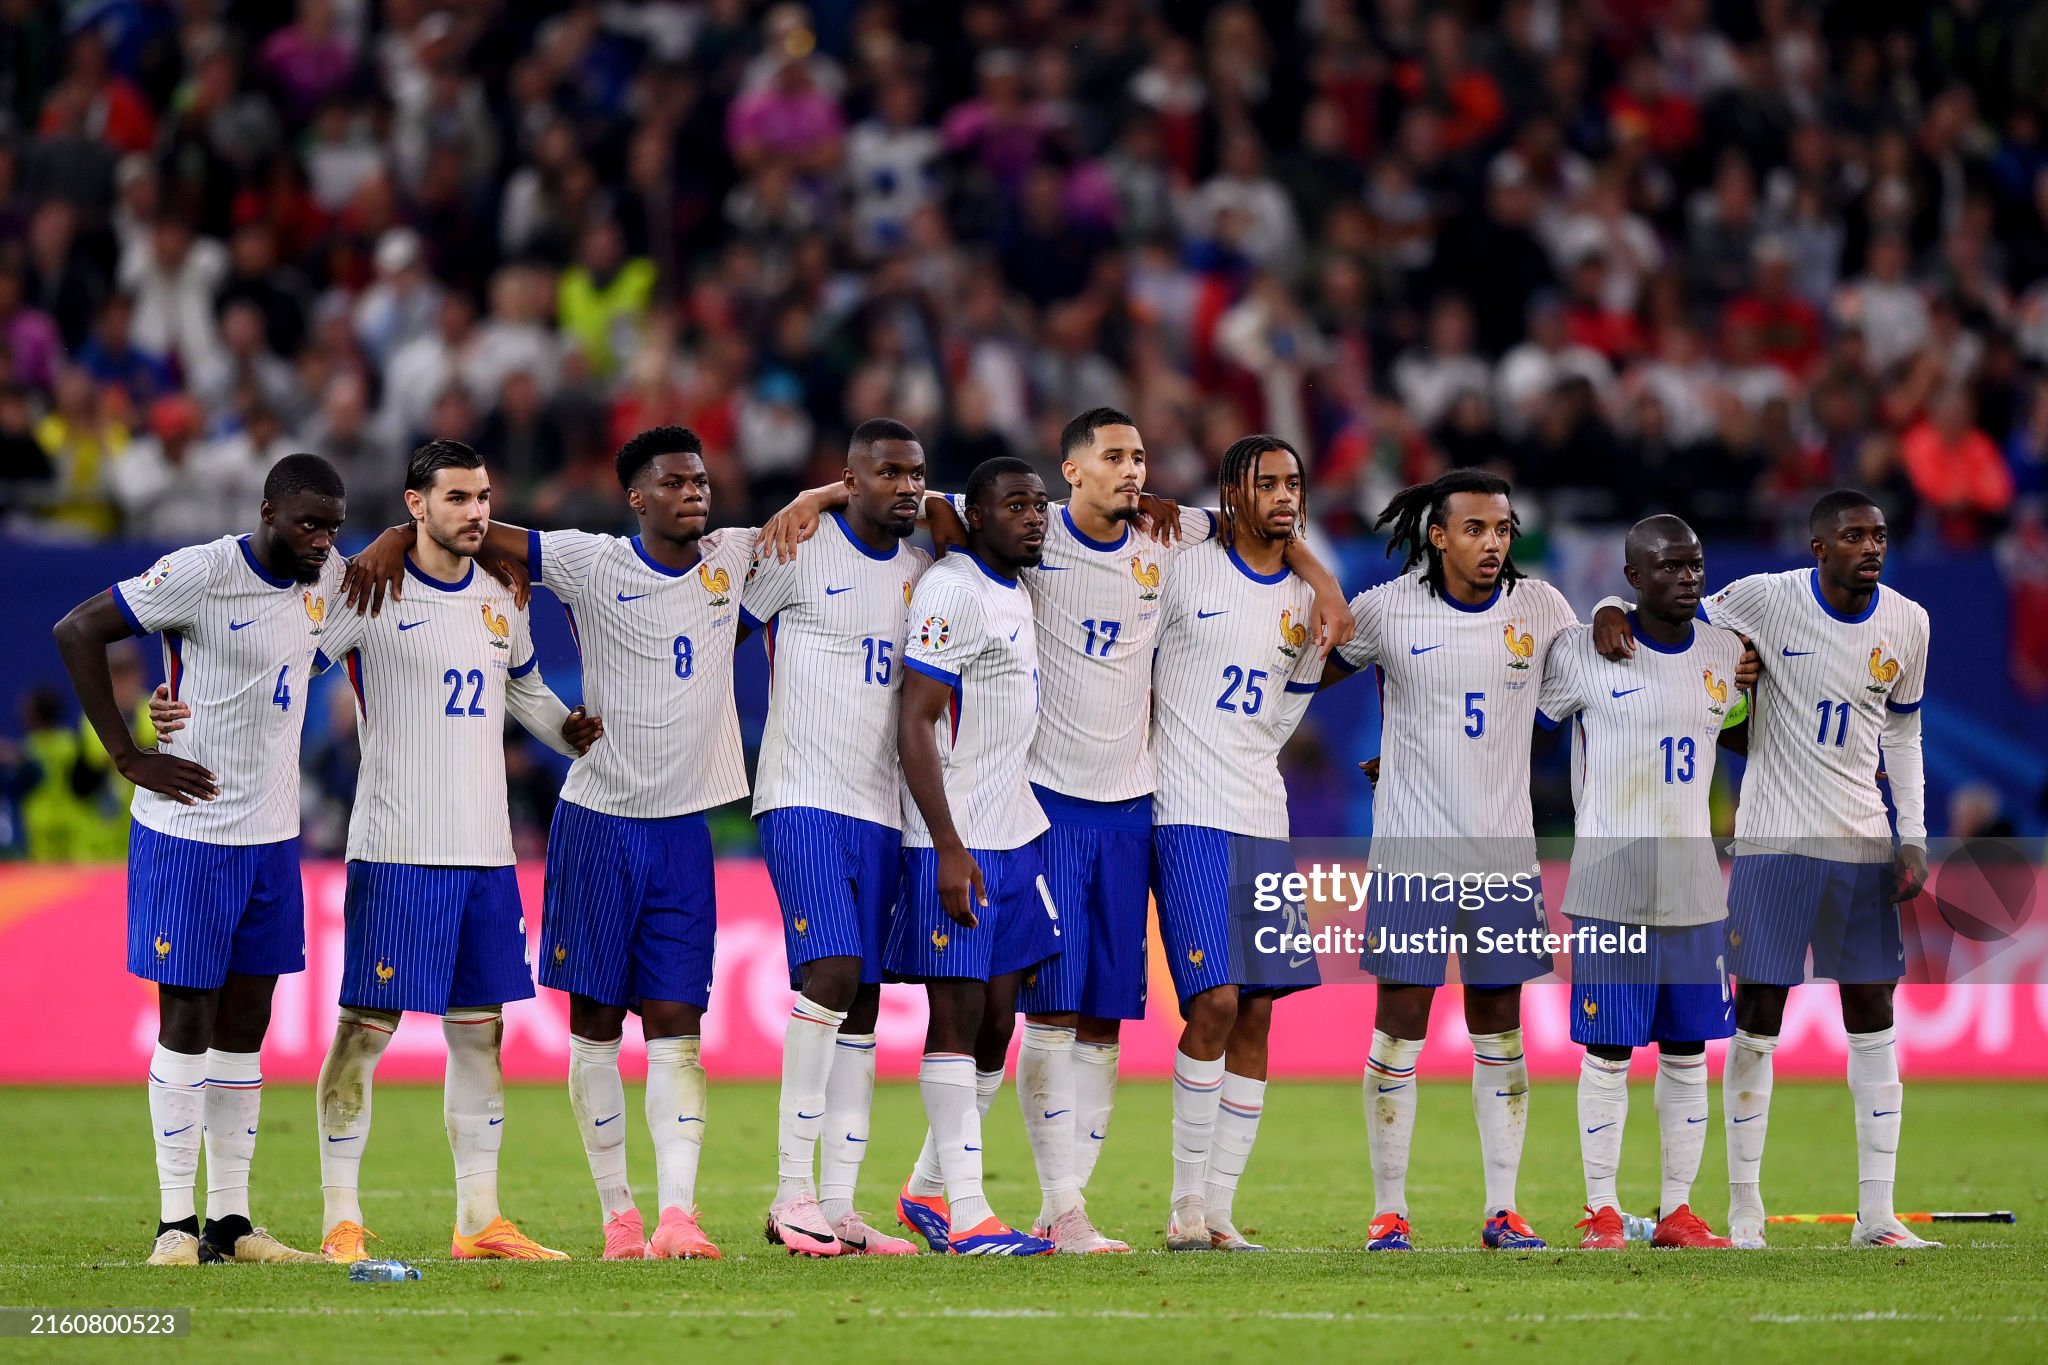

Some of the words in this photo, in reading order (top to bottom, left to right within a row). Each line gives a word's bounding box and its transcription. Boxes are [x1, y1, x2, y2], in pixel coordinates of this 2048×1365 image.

[673, 636, 694, 680] 8
[1081, 619, 1121, 656] 17
[862, 638, 894, 687] 15
[273, 664, 291, 712] 4
[444, 668, 486, 717] 22
[1216, 664, 1268, 717] 25
[1465, 692, 1485, 739] 5
[1816, 700, 1851, 747] 11
[1660, 736, 1696, 784] 13
